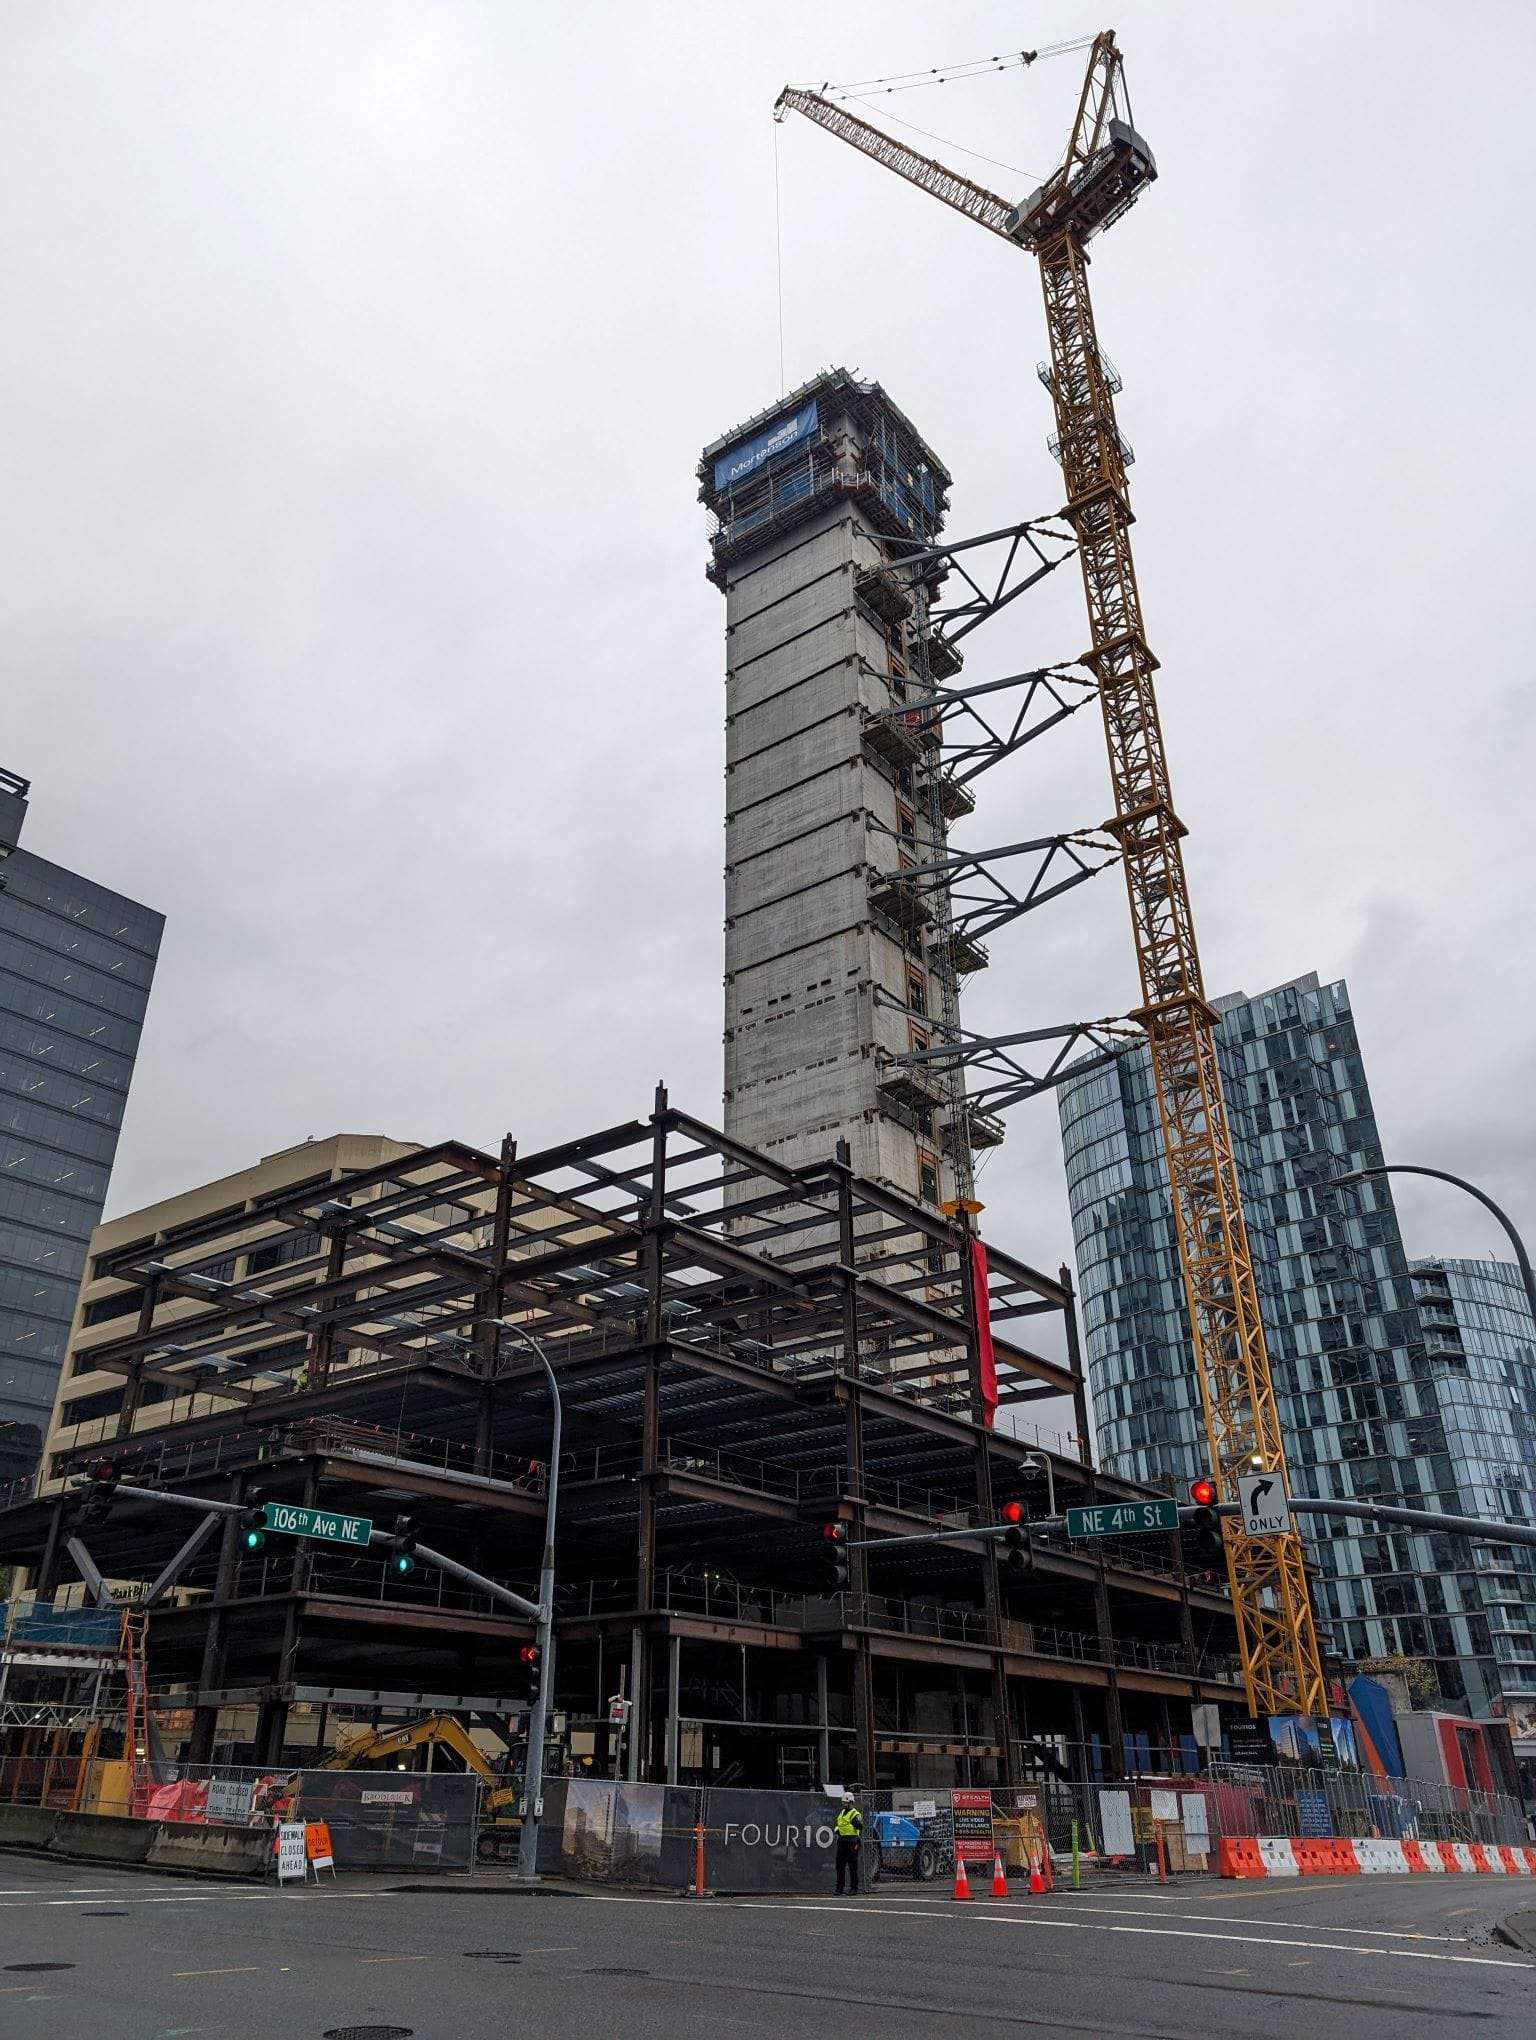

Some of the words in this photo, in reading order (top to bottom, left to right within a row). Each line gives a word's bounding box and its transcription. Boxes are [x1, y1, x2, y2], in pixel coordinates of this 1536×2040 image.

[731, 431, 798, 476] Mortenson
[273, 1508, 308, 1530] 106th
[312, 1515, 336, 1537] Ave
[341, 1520, 361, 1540] NE
[1082, 1510, 1105, 1533] NE
[1111, 1507, 1136, 1530] 4th
[1143, 1505, 1163, 1527] St
[1250, 1516, 1283, 1531] ONLY
[212, 1785, 226, 1795] ROAD
[954, 1809, 990, 1817] WARNING
[281, 1830, 304, 1840] SIDEWALK
[724, 1823, 834, 1848] FOUR10
[281, 1845, 303, 1855] CLOSED
[281, 1860, 302, 1870] AHEAD
